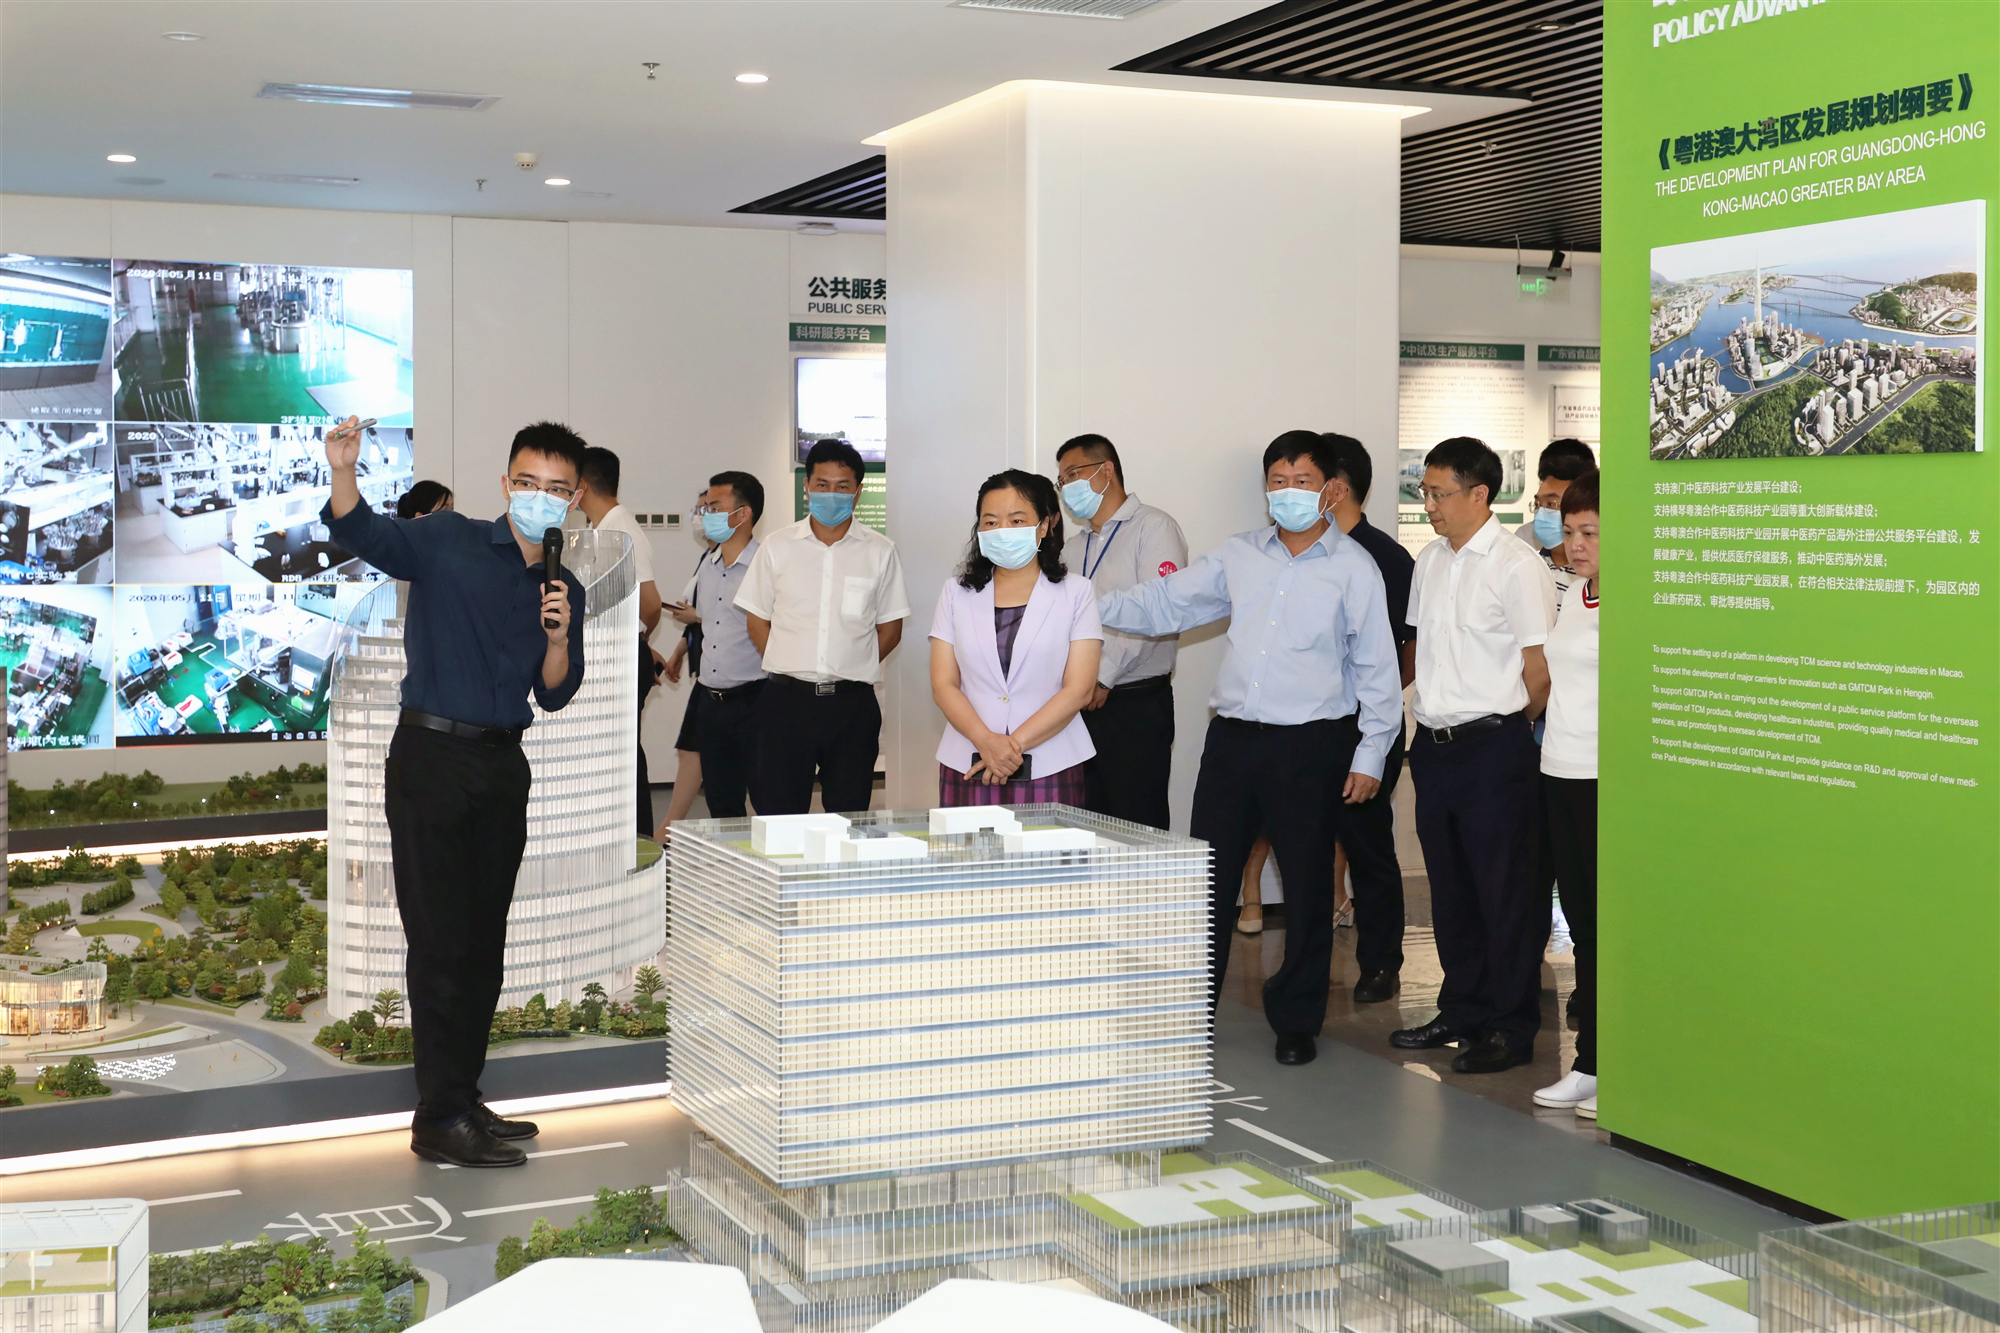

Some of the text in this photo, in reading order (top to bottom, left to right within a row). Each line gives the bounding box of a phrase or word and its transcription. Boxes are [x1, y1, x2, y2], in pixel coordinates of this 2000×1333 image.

[1653, 4, 1730, 47] POLICY
[1659, 73, 1973, 171] 《粤港澳大湾区发展规划纲要》
[1654, 120, 1985, 196] THE DEVELOPMENT PLAN FOR GUANGDONG-HONG
[1703, 165, 1926, 217] KONG-MACAO GREATER BAY AREA
[127, 268, 223, 281] 2020年05月11日
[808, 302, 853, 314] PUBLIC
[796, 326, 871, 341] 科研服务平台
[129, 593, 224, 604] 2020年05月11日
[1652, 644, 1659, 652] To
[1660, 646, 1681, 655] support
[1682, 647, 1691, 655] the
[1692, 648, 1711, 658] setting
[1732, 651, 1757, 660] platform
[1765, 653, 1798, 666] developing
[1799, 656, 1815, 665] TCM
[1816, 659, 1841, 667] science
[1842, 660, 1855, 669] and
[1856, 661, 1893, 674] technology
[1894, 664, 1928, 675] industries
[1938, 667, 1964, 678] Macao.
[1652, 664, 1659, 672] To
[1660, 667, 1681, 675] support
[1681, 667, 1691, 675] the
[1691, 668, 1728, 679] development
[1736, 674, 1754, 683] major
[1754, 675, 1777, 684] carriers
[1778, 676, 1787, 684] for
[1788, 677, 1820, 688] innovation
[1821, 681, 1837, 689] such
[1848, 682, 1876, 693] GMTCM
[1877, 684, 1894, 694] Park
[1895, 687, 1902, 695] in
[1903, 687, 1934, 700] Hengqin.
[1652, 684, 1659, 692] To
[1660, 687, 1682, 695] support
[1682, 687, 1707, 697] GMTCM
[1708, 690, 1722, 699] Park
[1731, 694, 1756, 705] carrying
[1768, 697, 1779, 705] the
[1780, 698, 1822, 710] development
[1823, 702, 1830, 711] of
[1838, 705, 1858, 714] public
[1860, 708, 1885, 716] service
[1886, 709, 1916, 720] platform
[1918, 712, 1928, 721] for
[1929, 713, 1942, 723] the
[1943, 716, 1978, 727] overseas
[1652, 701, 1683, 710] registration
[1690, 704, 1705, 713] TCM
[1706, 707, 1733, 717] products,
[1734, 710, 1767, 722] developing
[1768, 713, 1802, 724] healthcare
[1802, 717, 1836, 729] industries,
[1837, 722, 1868, 734] providing
[1869, 726, 1893, 737] quality
[1894, 729, 1922, 738] medical
[1923, 732, 1937, 740] and
[1939, 732, 1978, 745] healthcare
[1652, 717, 1676, 726] services,
[1688, 721, 1717, 732] promoting
[1718, 724, 1728, 732] the
[1728, 726, 1756, 736] overseas
[1756, 728, 1796, 740] development
[1796, 733, 1804, 741] of
[1804, 733, 1821, 744] TCM.
[1651, 735, 1659, 744] To
[1660, 738, 1681, 747] support
[1682, 740, 1692, 748] the
[1692, 741, 1730, 753] development
[1738, 747, 1764, 758] GMTCM
[1766, 750, 1781, 760] Park
[1782, 754, 1794, 762] and
[1795, 756, 1820, 766] provide
[1821, 759, 1852, 770] guidance
[1864, 763, 1880, 774] R&D
[1882, 767, 1895, 776] and
[1897, 770, 1928, 780] approval
[1929, 772, 1938, 781] of
[1939, 775, 1955, 784] new
[1956, 778, 1978, 787] medi-
[1651, 752, 1663, 760] cine
[1664, 752, 1677, 761] Park
[1678, 756, 1709, 766] enterprises
[1716, 761, 1750, 772] accordance
[1751, 766, 1764, 774] with
[1765, 768, 1790, 778] relevant
[1790, 770, 1805, 780] laws
[1806, 774, 1818, 782] and
[1820, 776, 1857, 788] regulations.
